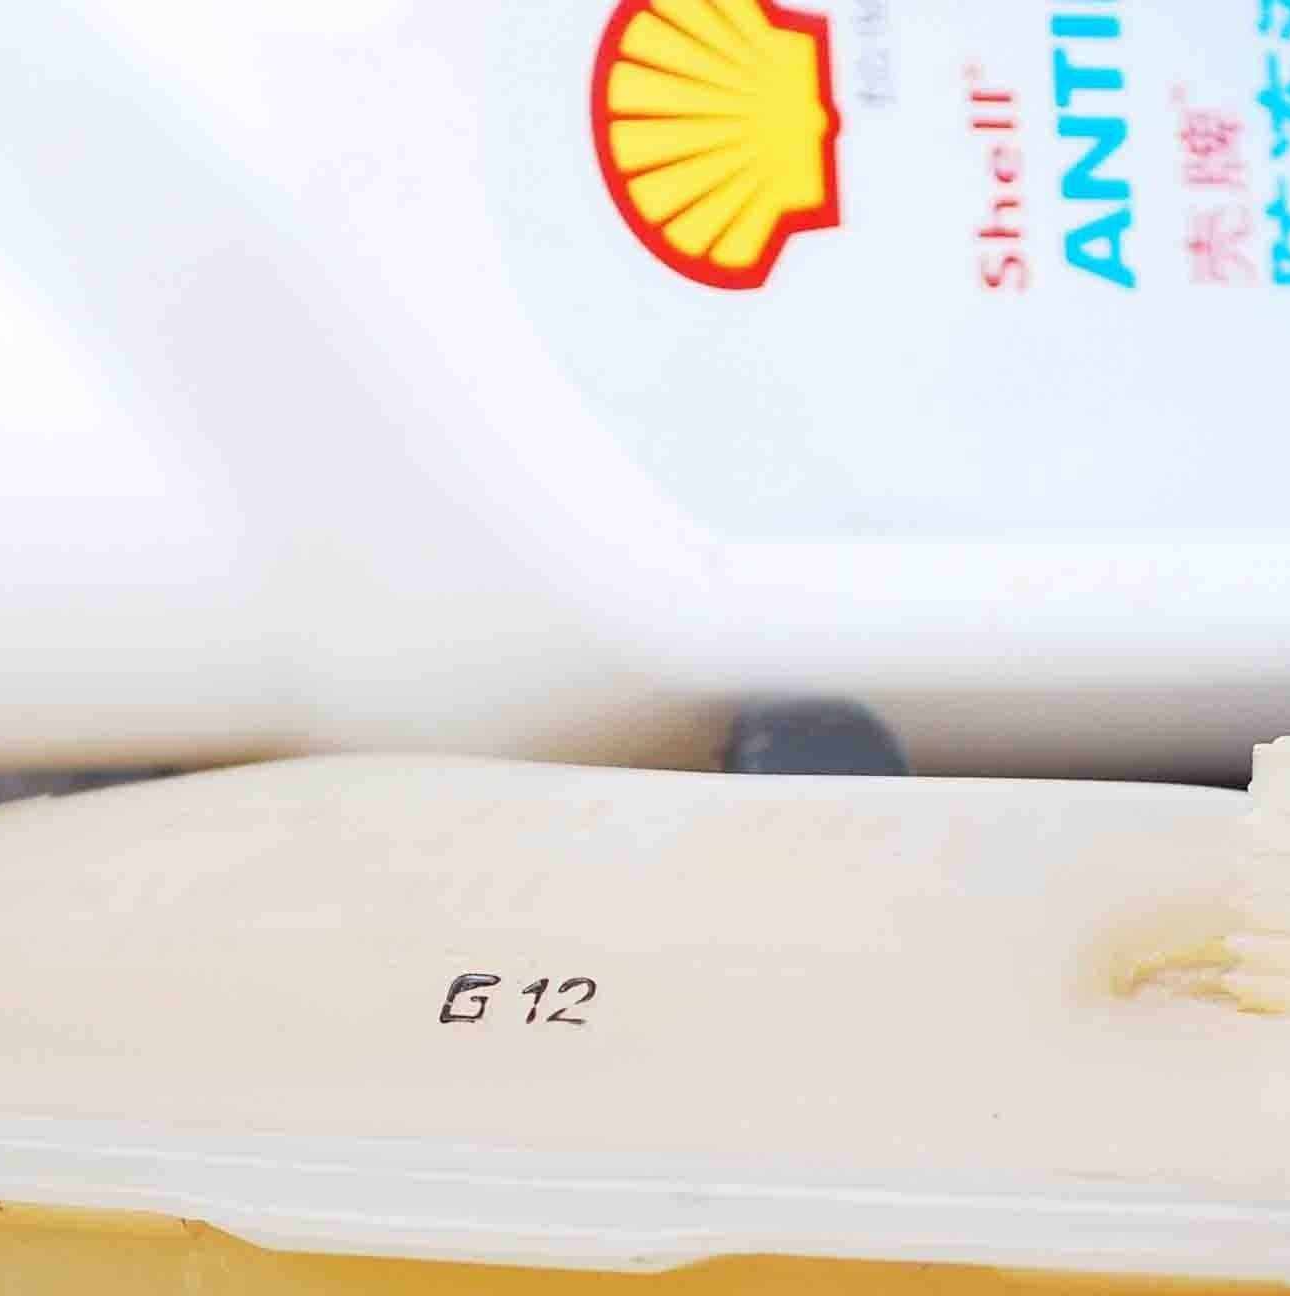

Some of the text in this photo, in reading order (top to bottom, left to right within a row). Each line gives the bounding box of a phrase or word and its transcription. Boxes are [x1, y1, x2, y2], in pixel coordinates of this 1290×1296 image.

[968, 92, 1029, 292] Shell
[1050, 0, 1136, 290] ANTI
[1181, 108, 1259, 286] 壳牌
